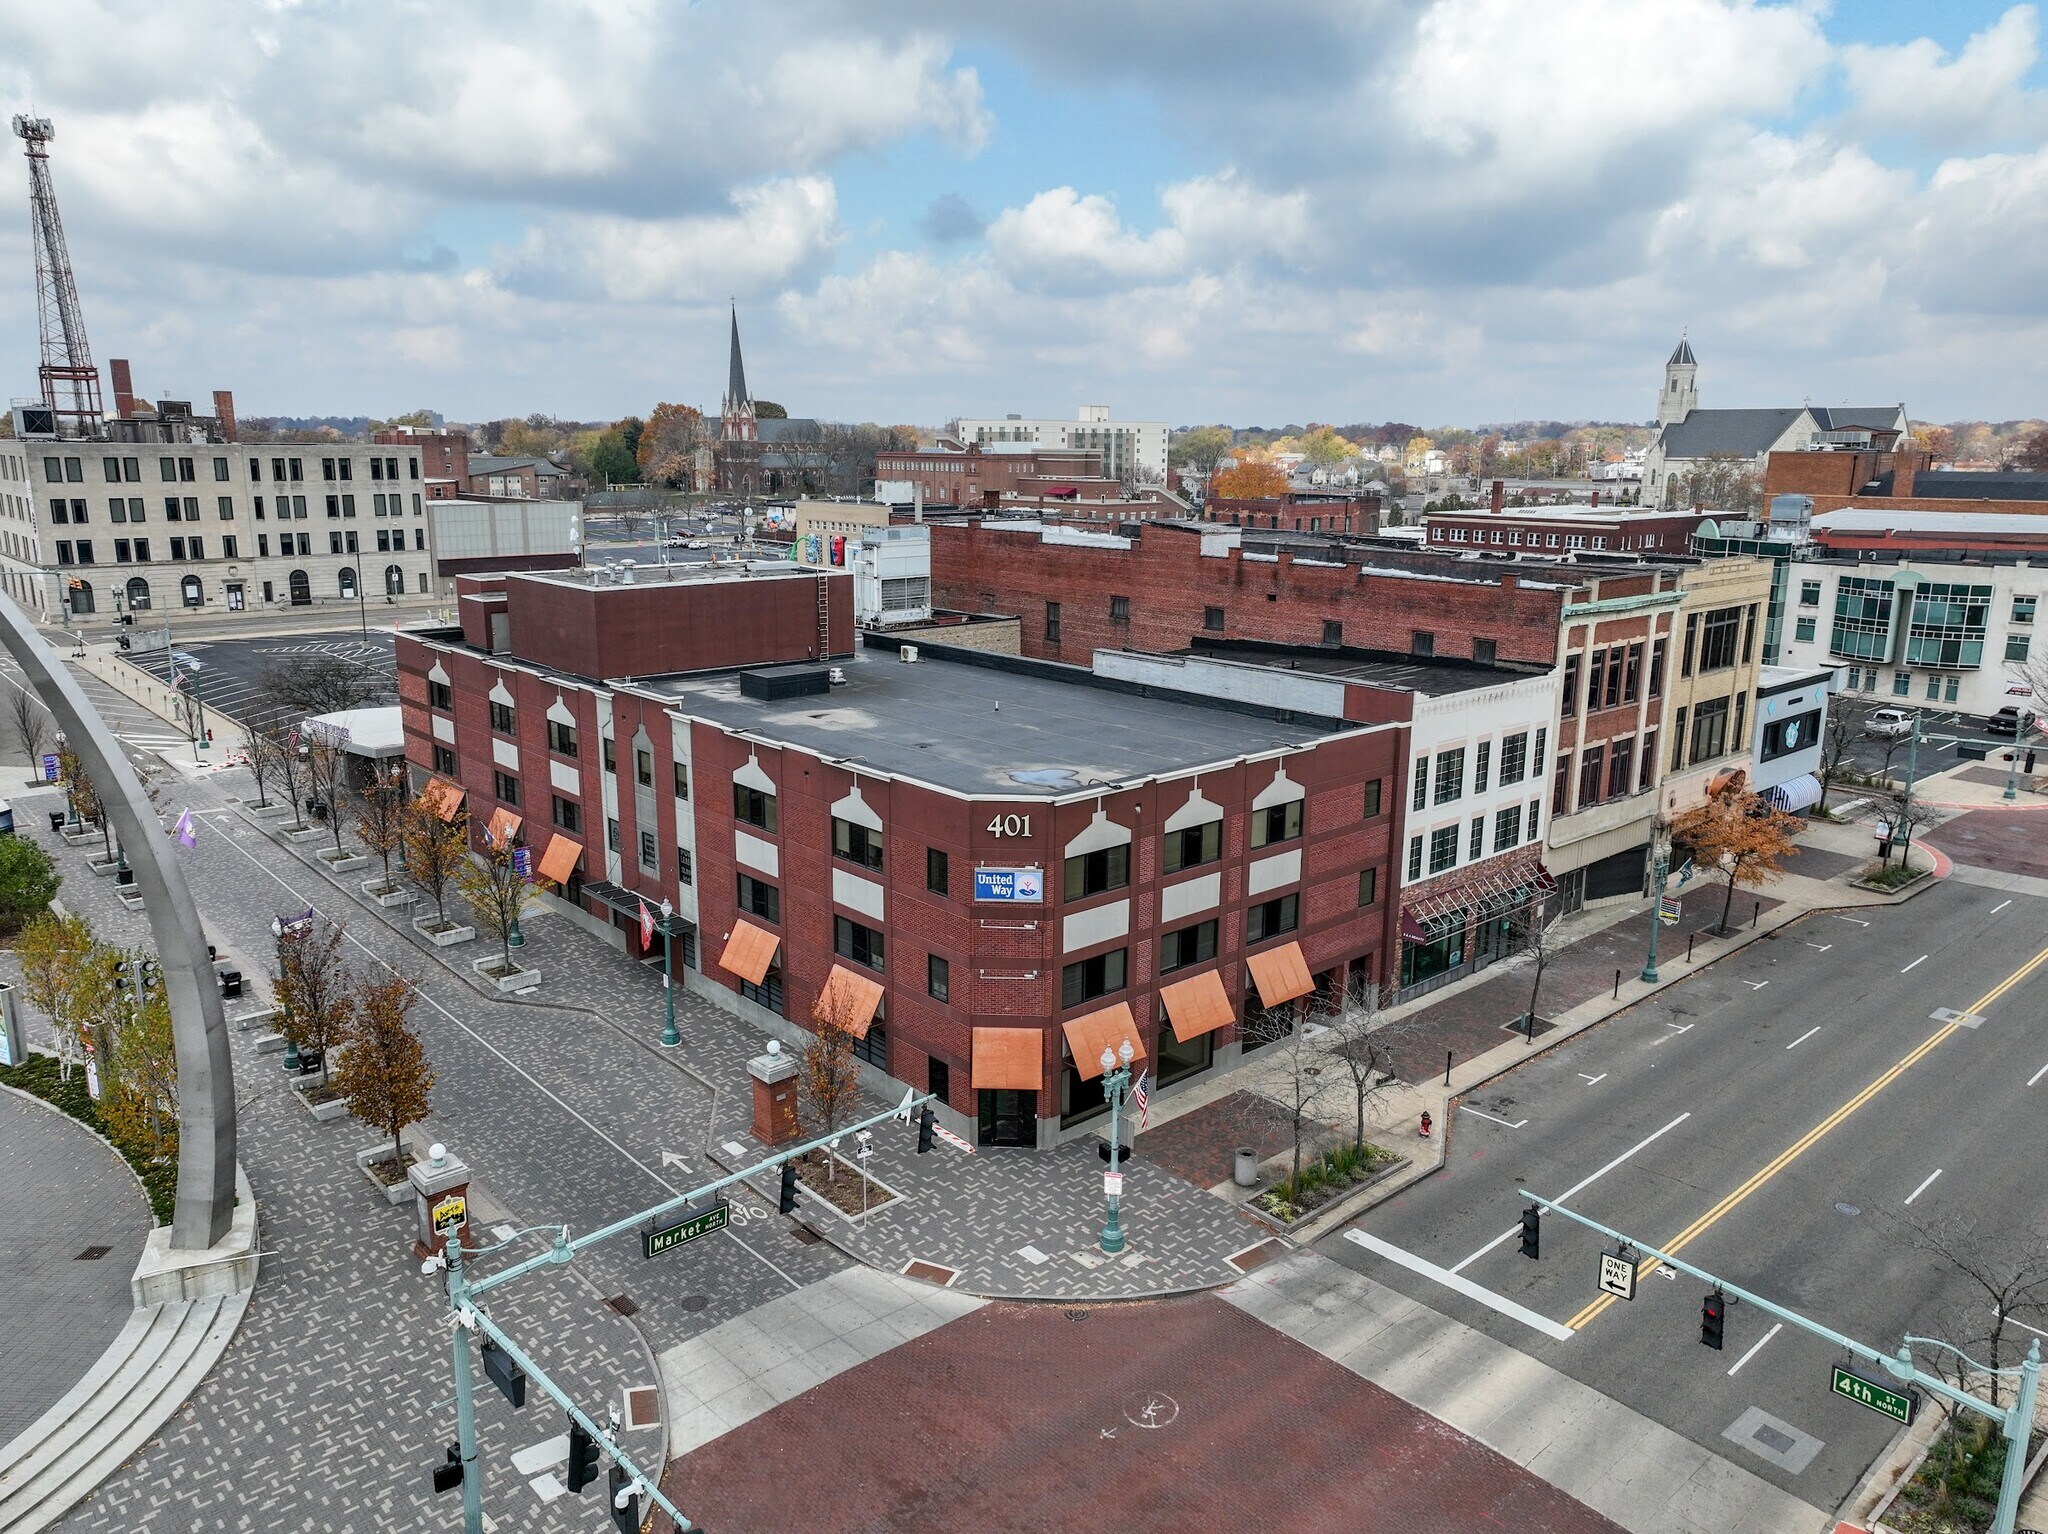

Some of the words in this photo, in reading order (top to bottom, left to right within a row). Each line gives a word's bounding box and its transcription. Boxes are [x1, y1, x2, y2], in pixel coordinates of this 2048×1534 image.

[986, 813, 1033, 838] 401
[978, 874, 1013, 885] United
[992, 884, 1013, 898] Way
[704, 1218, 723, 1230] NORTH
[654, 1222, 701, 1251] Market
[708, 1212, 720, 1223] AVE
[1606, 1259, 1627, 1273] ONE
[1605, 1268, 1627, 1282] WAY
[1839, 1378, 1872, 1403] 4th
[1885, 1395, 1896, 1405] ST
[1876, 1400, 1904, 1417] NORTH
